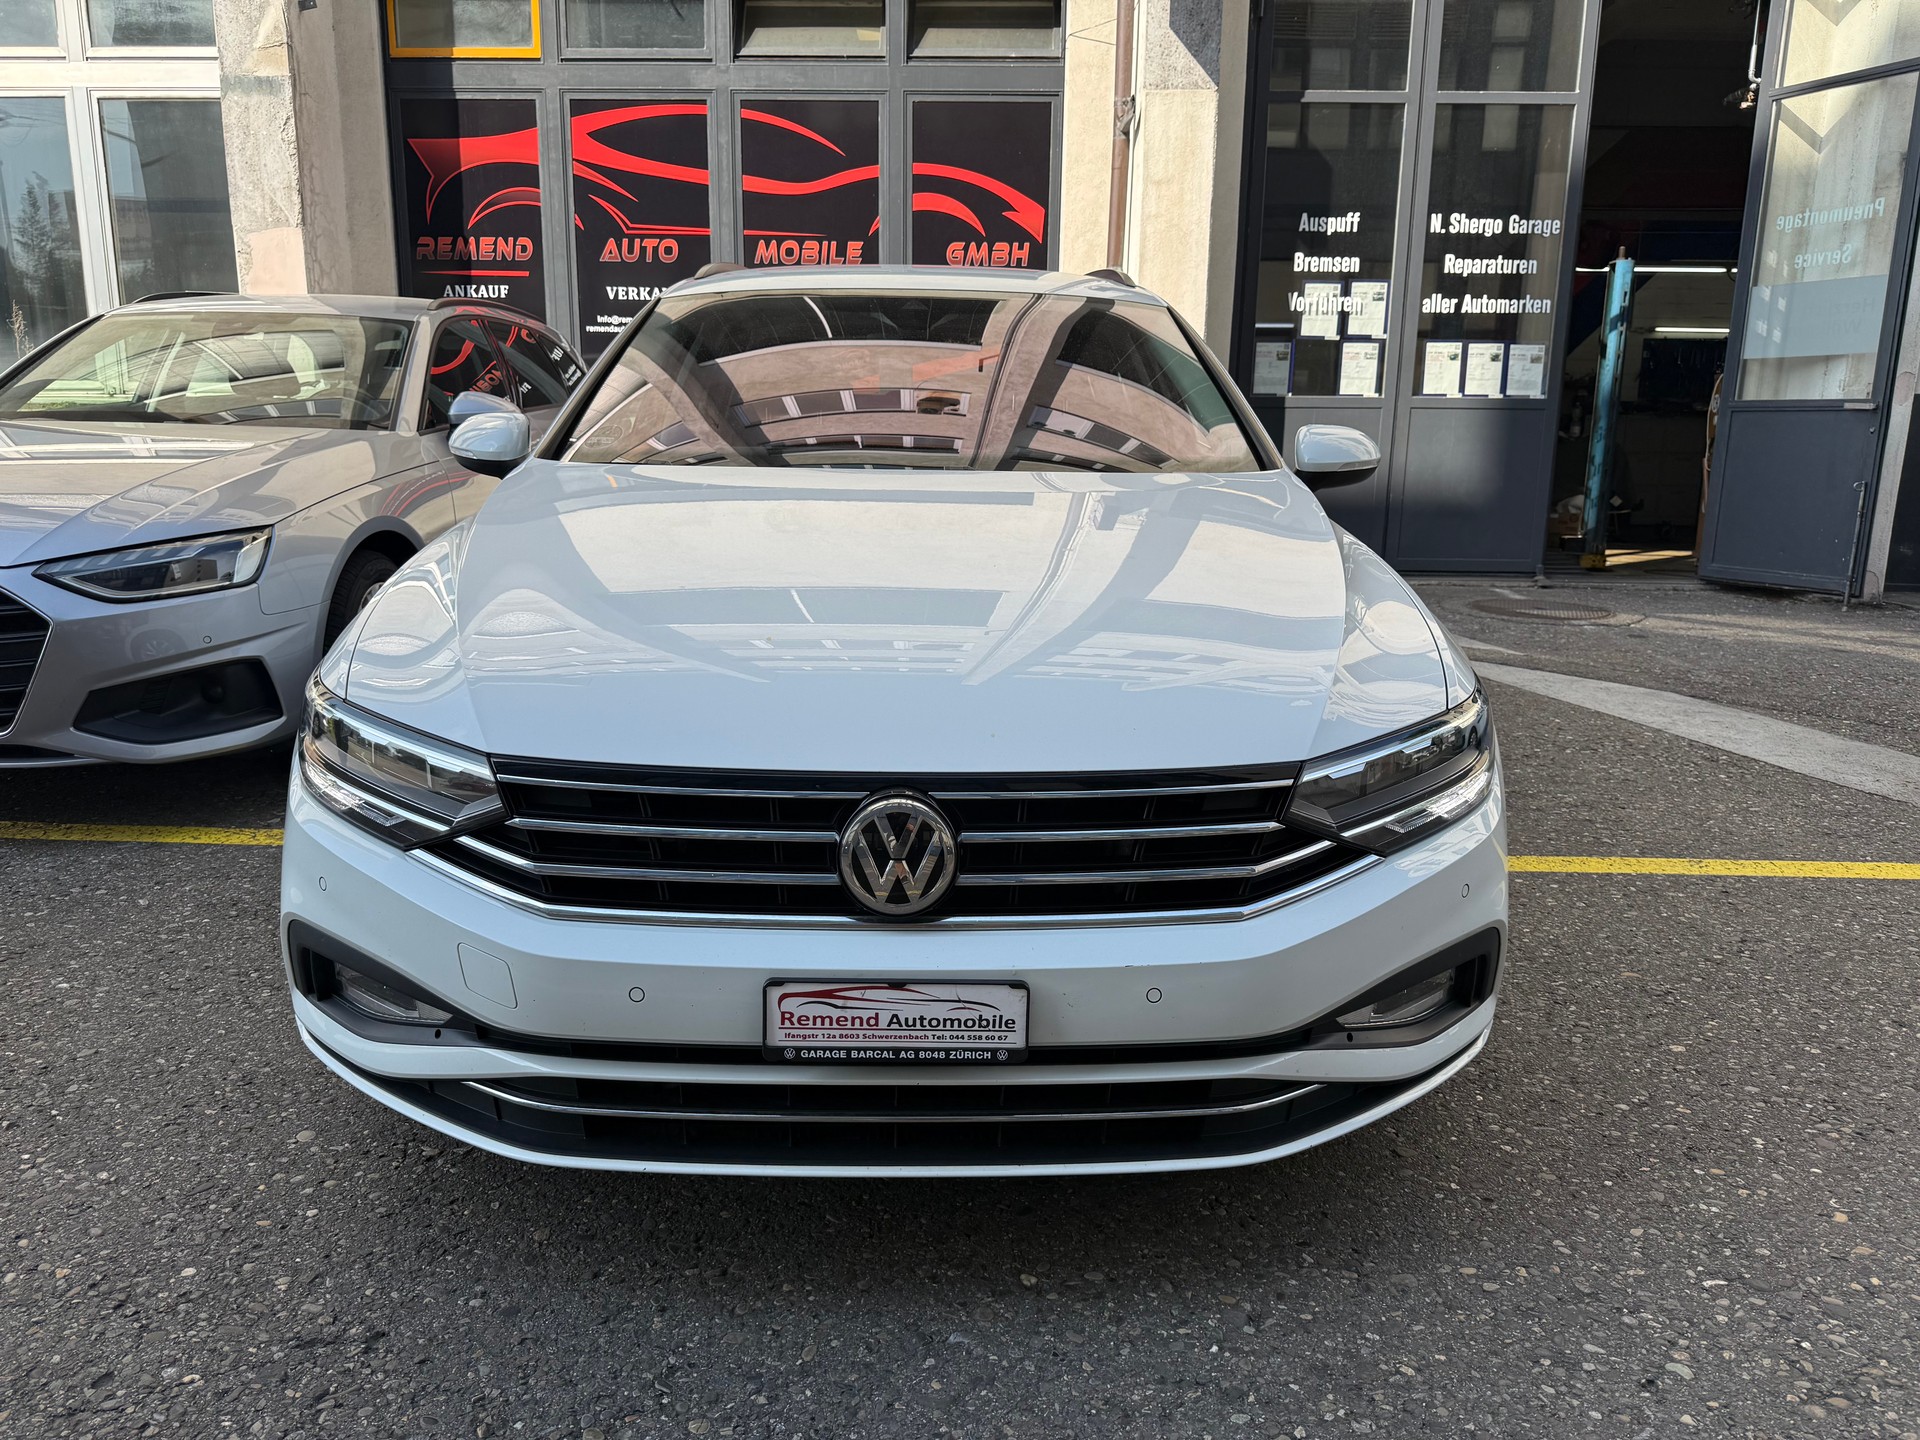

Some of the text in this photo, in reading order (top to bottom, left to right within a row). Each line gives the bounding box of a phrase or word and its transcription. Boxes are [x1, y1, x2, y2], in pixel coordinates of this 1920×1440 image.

[1298, 212, 1361, 236] Auspuff
[1430, 213, 1561, 238] N. Shergo Garage
[416, 236, 1031, 267] REMEND AUTO MOBILE GMBH
[1293, 252, 1361, 273] Bremsen
[1443, 254, 1538, 277] Reparaturen
[443, 285, 510, 299] ANKAUF
[605, 286, 668, 301] VERKA
[1287, 291, 1362, 312] Vorführen
[1421, 293, 1551, 314] aller Automarken
[780, 1010, 1016, 1030] Remend Automobile
[839, 1032, 860, 1040] 8603
[862, 1033, 930, 1041] Schwerzenbach
[997, 1034, 1008, 1042] 67
[800, 1050, 847, 1059] GARAGE
[850, 1050, 896, 1059] BARCAL
[899, 1050, 915, 1059] AG
[918, 1050, 946, 1059] 8048
[949, 1049, 992, 1060] ZÜRICH
